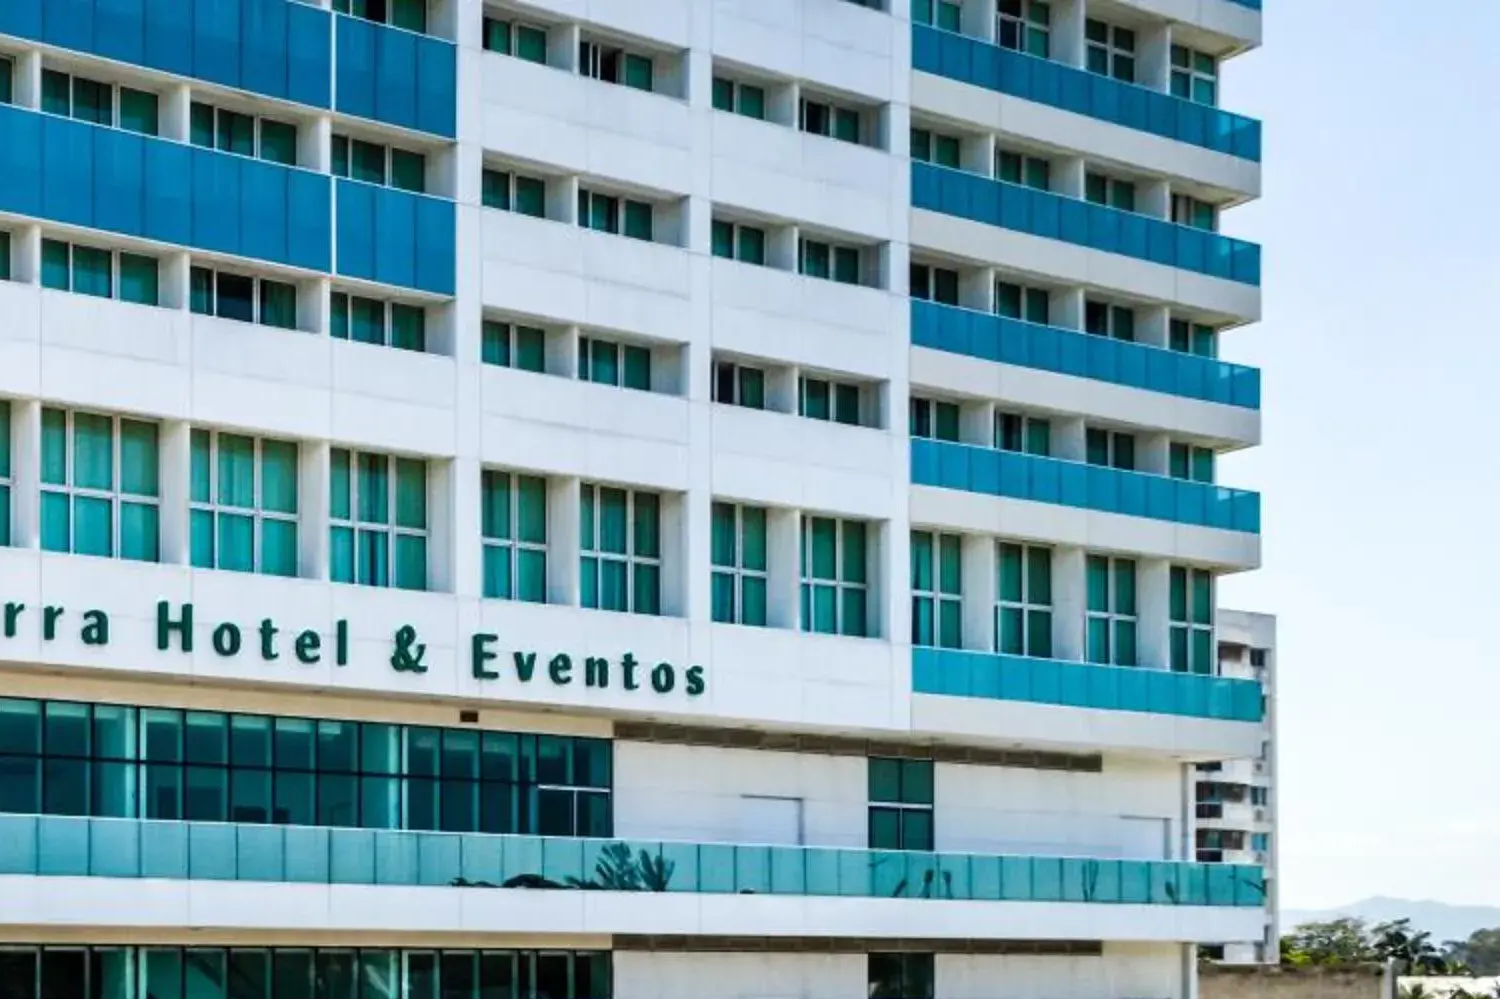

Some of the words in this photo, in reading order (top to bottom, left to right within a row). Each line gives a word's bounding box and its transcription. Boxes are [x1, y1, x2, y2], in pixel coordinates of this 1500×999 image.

[157, 601, 347, 667] Hotel
[390, 625, 428, 674] &
[472, 633, 705, 696] Eventos
